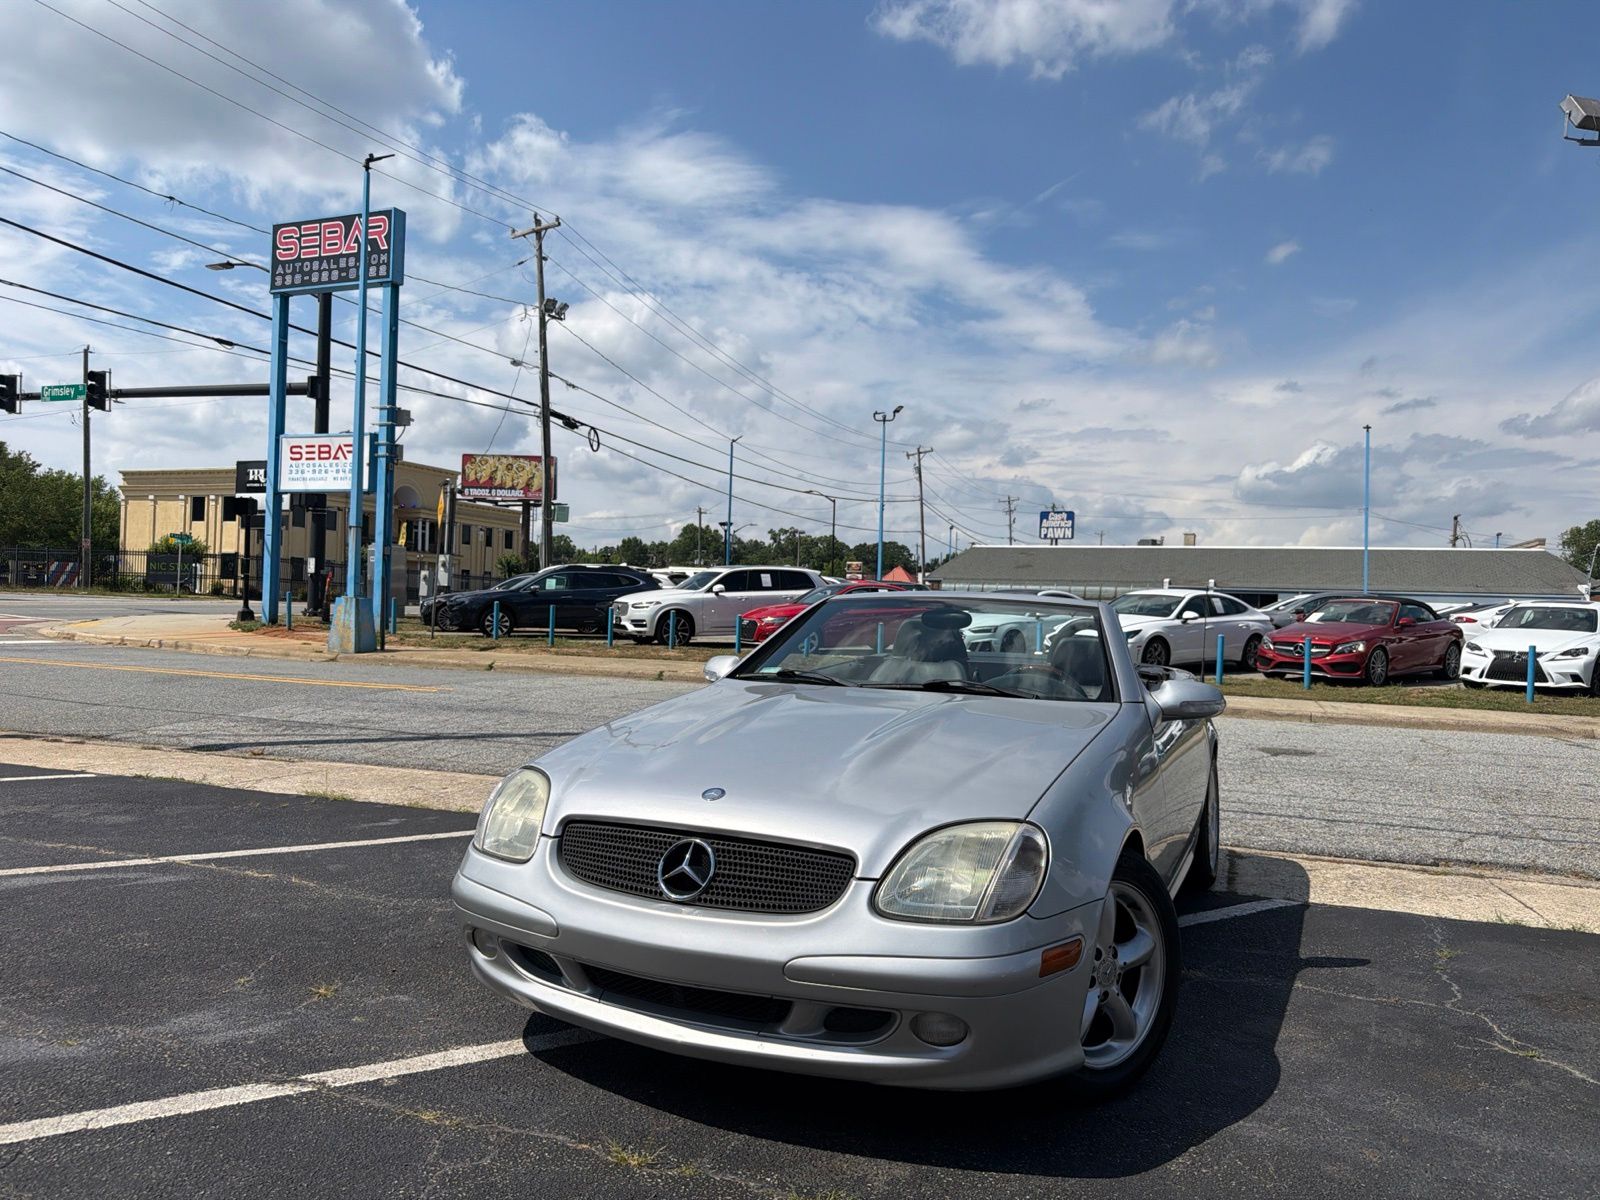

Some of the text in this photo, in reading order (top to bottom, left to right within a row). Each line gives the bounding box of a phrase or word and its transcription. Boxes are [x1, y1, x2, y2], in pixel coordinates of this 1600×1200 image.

[276, 215, 389, 261] SEBAR
[276, 253, 388, 275] AUTOSALES.OM
[275, 265, 387, 286] 336-926-822
[43, 386, 75, 398] Grimsley
[464, 488, 469, 496] 6
[1041, 527, 1072, 539] PAWN
[150, 562, 167, 571] NIC
